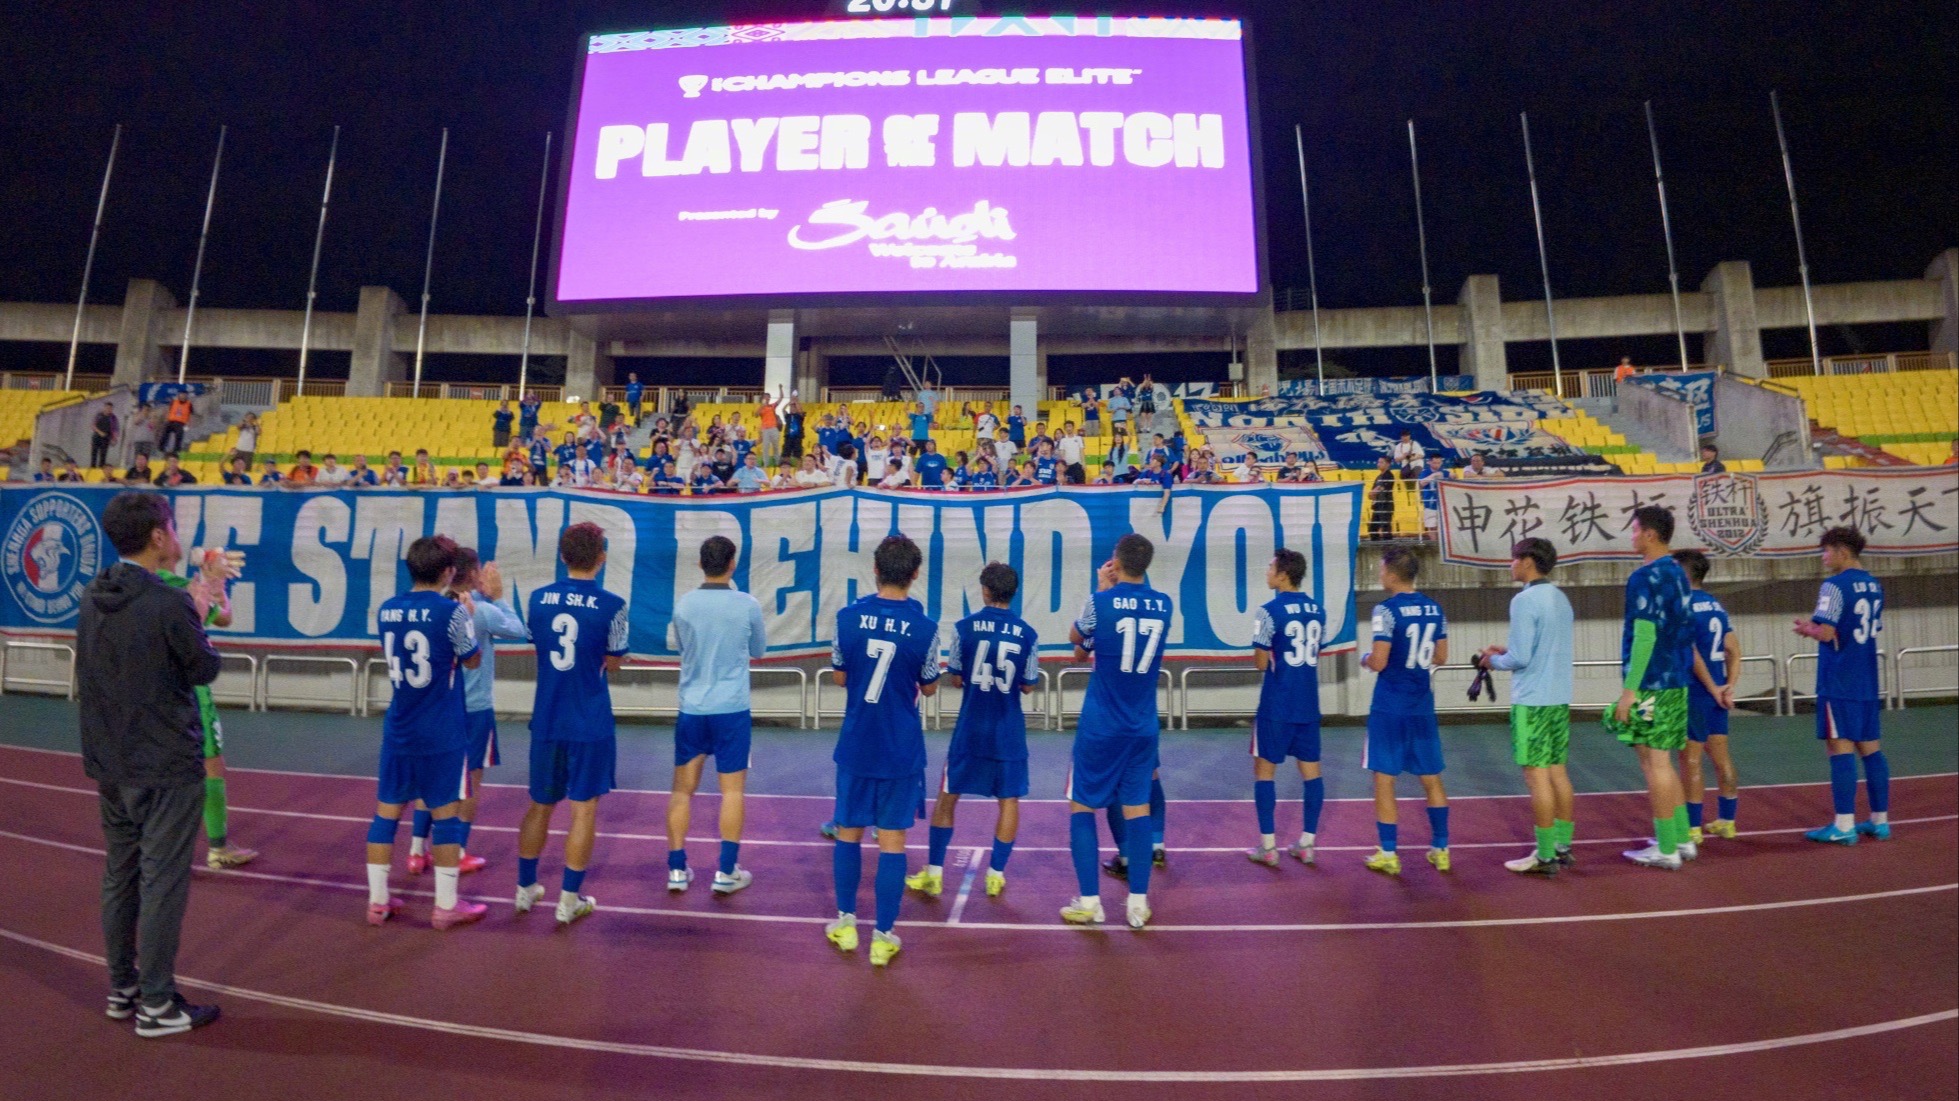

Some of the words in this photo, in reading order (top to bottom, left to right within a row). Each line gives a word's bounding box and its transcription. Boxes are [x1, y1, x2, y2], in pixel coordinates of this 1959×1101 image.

[722, 70, 911, 92] CHAMPIONS
[916, 68, 1040, 86] LEAGUE
[1045, 68, 1134, 85] ELITE
[595, 114, 871, 180] PLAYER
[953, 111, 1225, 169] MATCH
[1699, 517, 1758, 529] SHENHUA
[1716, 529, 1746, 539] 2012
[1778, 484, 1959, 539] 旗振天
[1129, 492, 1353, 647] YOU
[540, 592, 561, 605] JIN
[565, 592, 599, 610] SH.K.
[1113, 597, 1138, 610] GAO
[1143, 599, 1167, 612] T.Y.
[550, 612, 578, 671] 3
[859, 614, 878, 630] XU
[884, 617, 911, 637] H.Y.
[973, 620, 995, 632] HAN
[1001, 623, 1024, 638] J.W.
[1116, 617, 1164, 674] 17
[1284, 620, 1322, 667] 38
[1405, 622, 1437, 669] 16
[1708, 616, 1725, 661] 2
[384, 630, 432, 689] 43
[864, 638, 897, 704] 7
[970, 639, 1021, 694] 45
